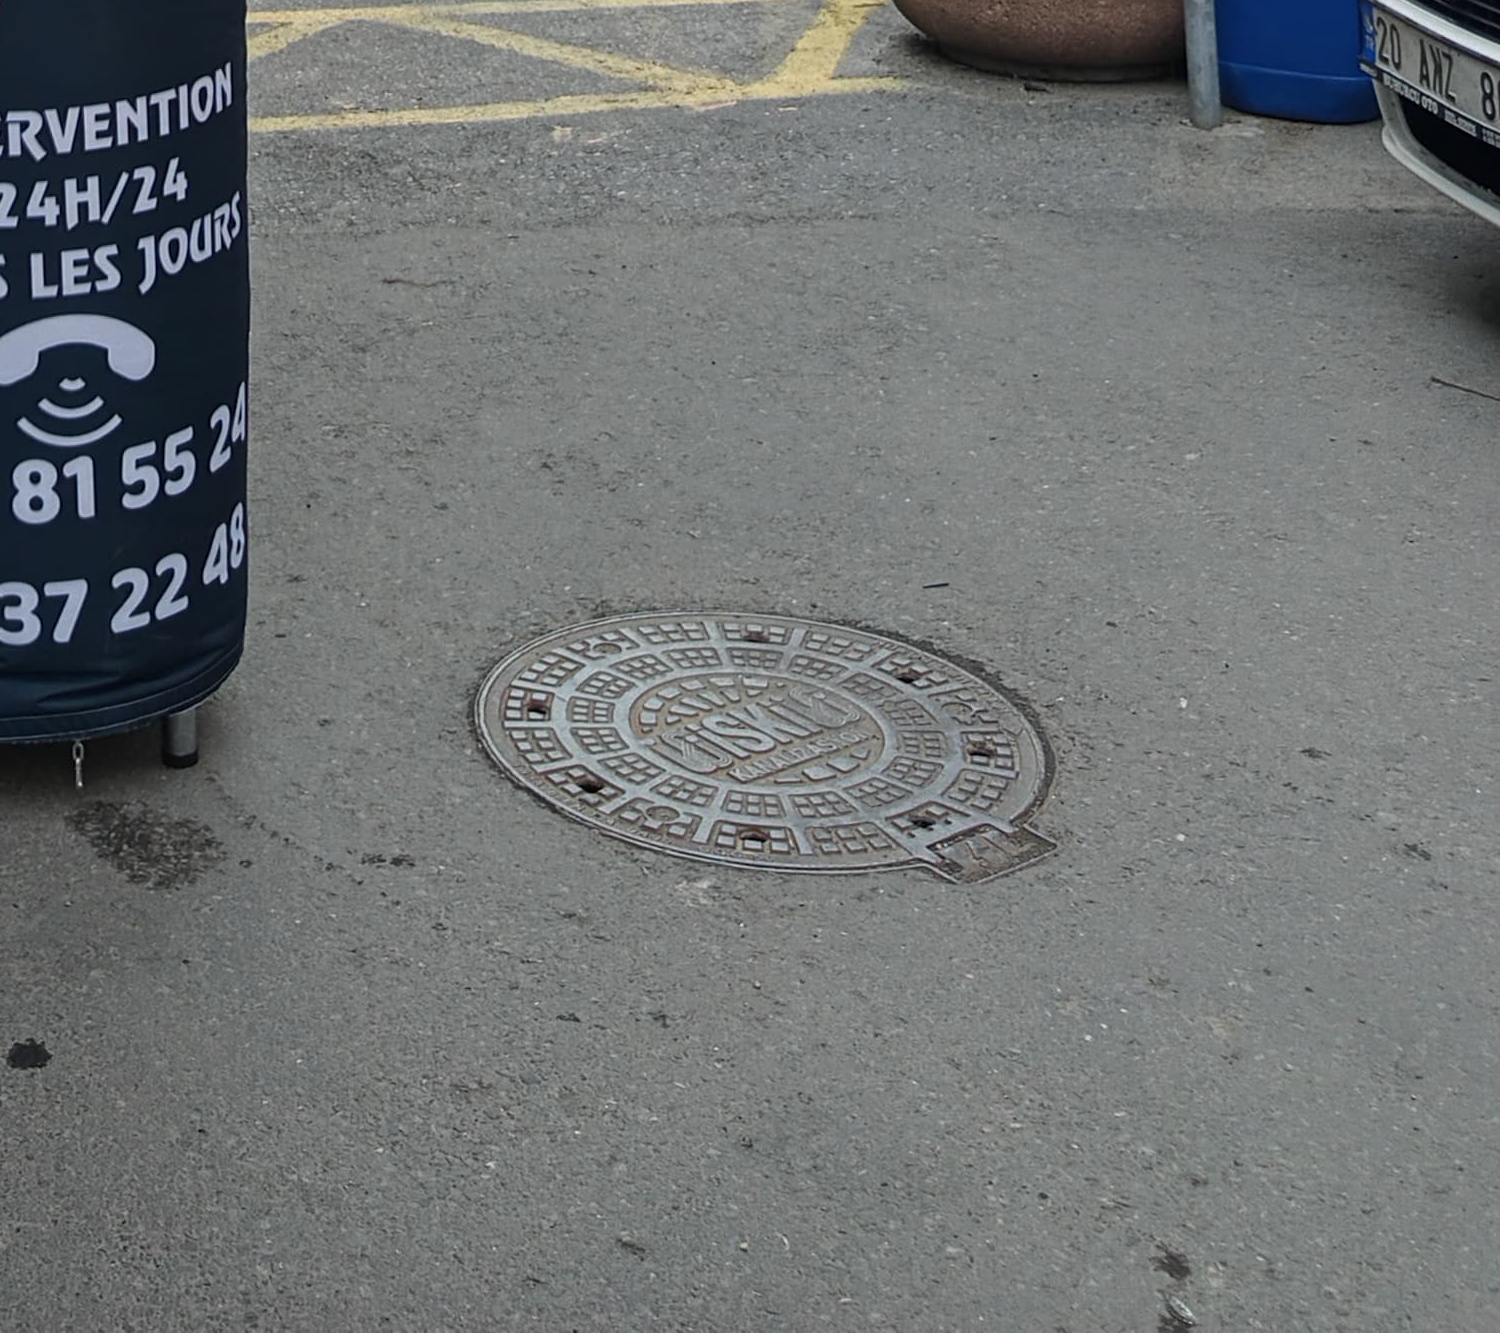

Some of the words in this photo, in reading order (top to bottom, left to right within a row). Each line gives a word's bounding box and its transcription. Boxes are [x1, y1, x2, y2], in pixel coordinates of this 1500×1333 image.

[1376, 16, 1402, 71] 20
[1419, 38, 1457, 105] ANZ
[1479, 70, 1500, 123] 8
[30, 244, 121, 299] LES
[137, 191, 241, 294] JOURS
[12, 455, 95, 524] 81
[121, 426, 196, 510] 55
[209, 381, 246, 473] 24
[111, 553, 189, 634] 22
[202, 502, 245, 585] 48
